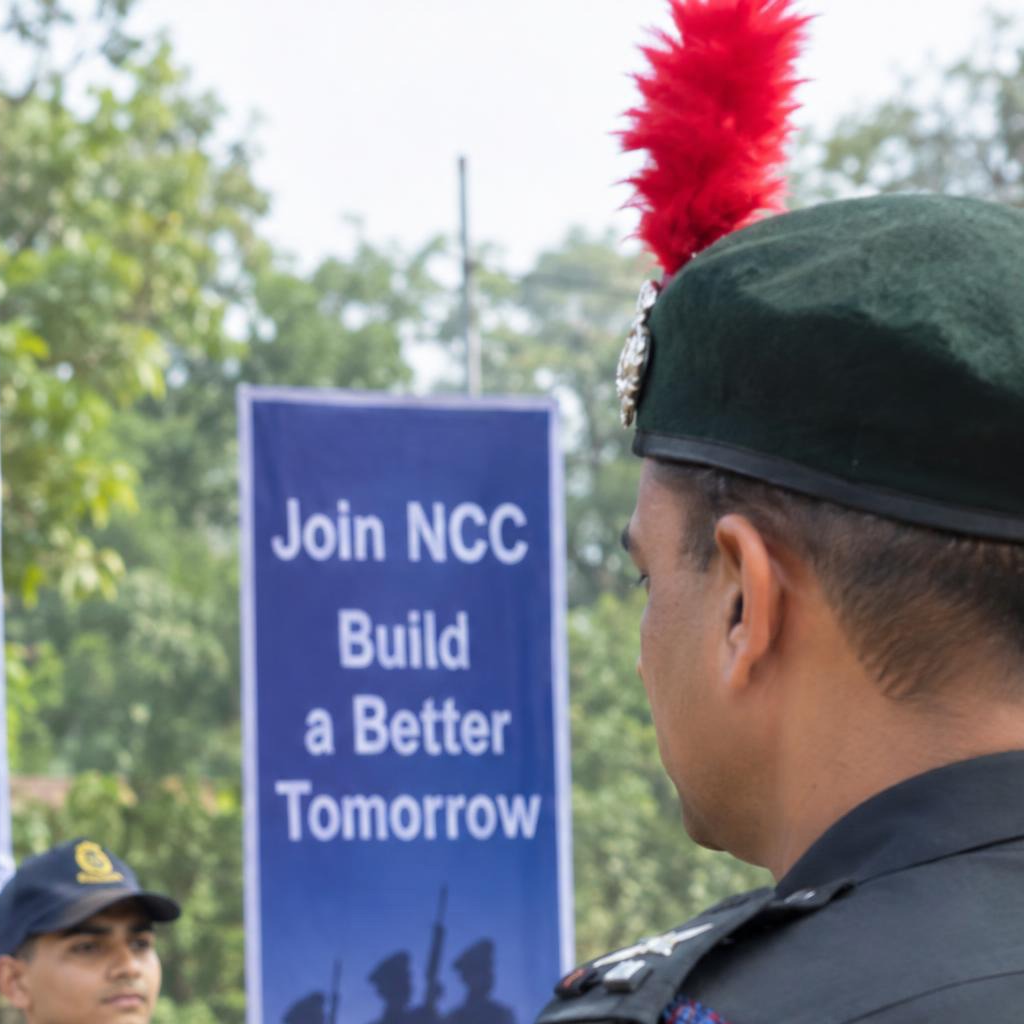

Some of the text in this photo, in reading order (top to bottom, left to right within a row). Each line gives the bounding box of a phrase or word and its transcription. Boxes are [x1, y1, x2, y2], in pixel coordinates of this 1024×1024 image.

[271, 497, 529, 565] Join NCC
[338, 608, 470, 670] Build
[304, 694, 512, 757] a Better
[275, 779, 542, 842] Tomorrow
